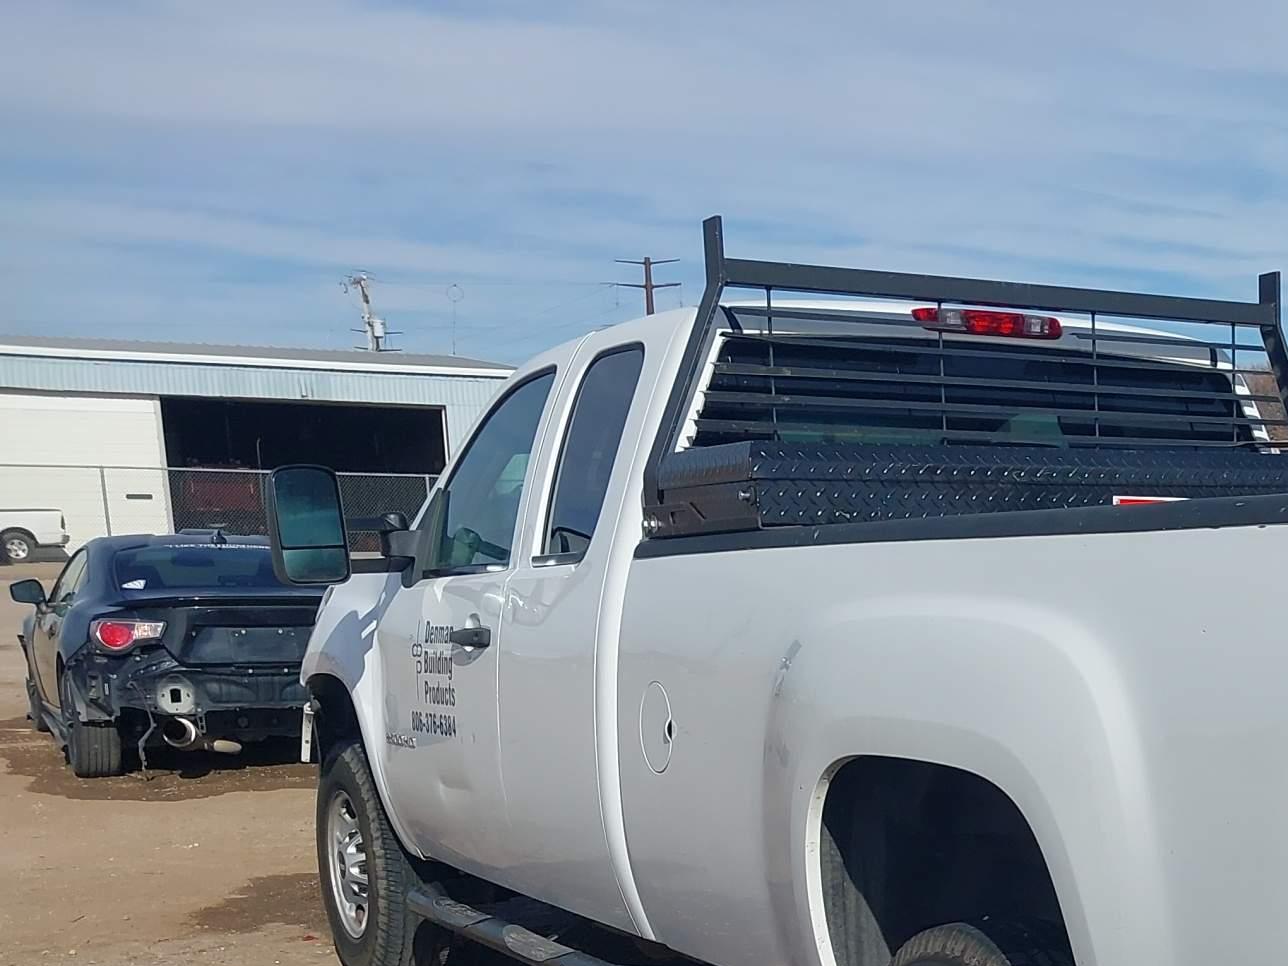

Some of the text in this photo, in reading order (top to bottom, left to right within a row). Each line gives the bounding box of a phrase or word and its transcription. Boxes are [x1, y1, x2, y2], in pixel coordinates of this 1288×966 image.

[424, 651, 453, 680] Building
[425, 681, 456, 707] Products
[411, 711, 457, 737] 806-376-6384
